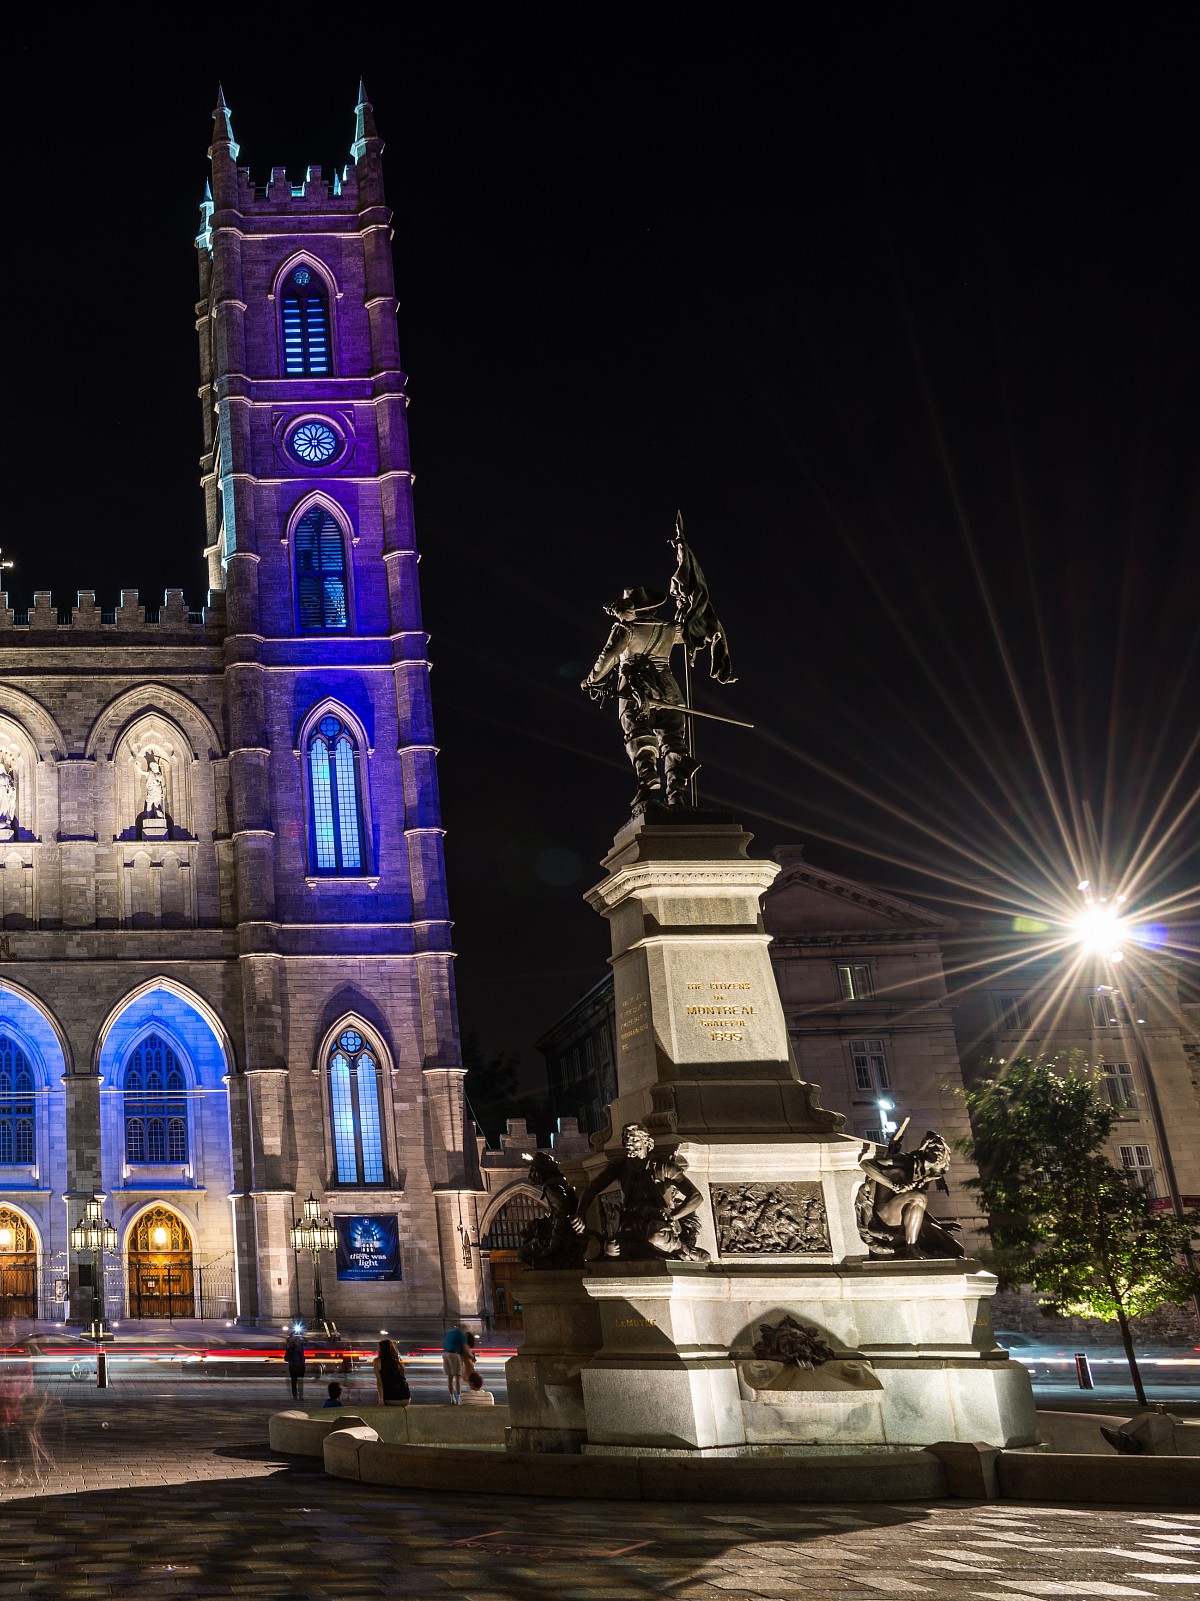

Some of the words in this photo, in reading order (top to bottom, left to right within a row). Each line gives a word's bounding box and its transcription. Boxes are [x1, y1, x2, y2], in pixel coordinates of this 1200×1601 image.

[709, 981, 751, 990] CITIZENS
[686, 1004, 758, 1015] MONTREAL
[700, 1018, 748, 1027] GRATEFUL
[358, 1259, 378, 1268] light
